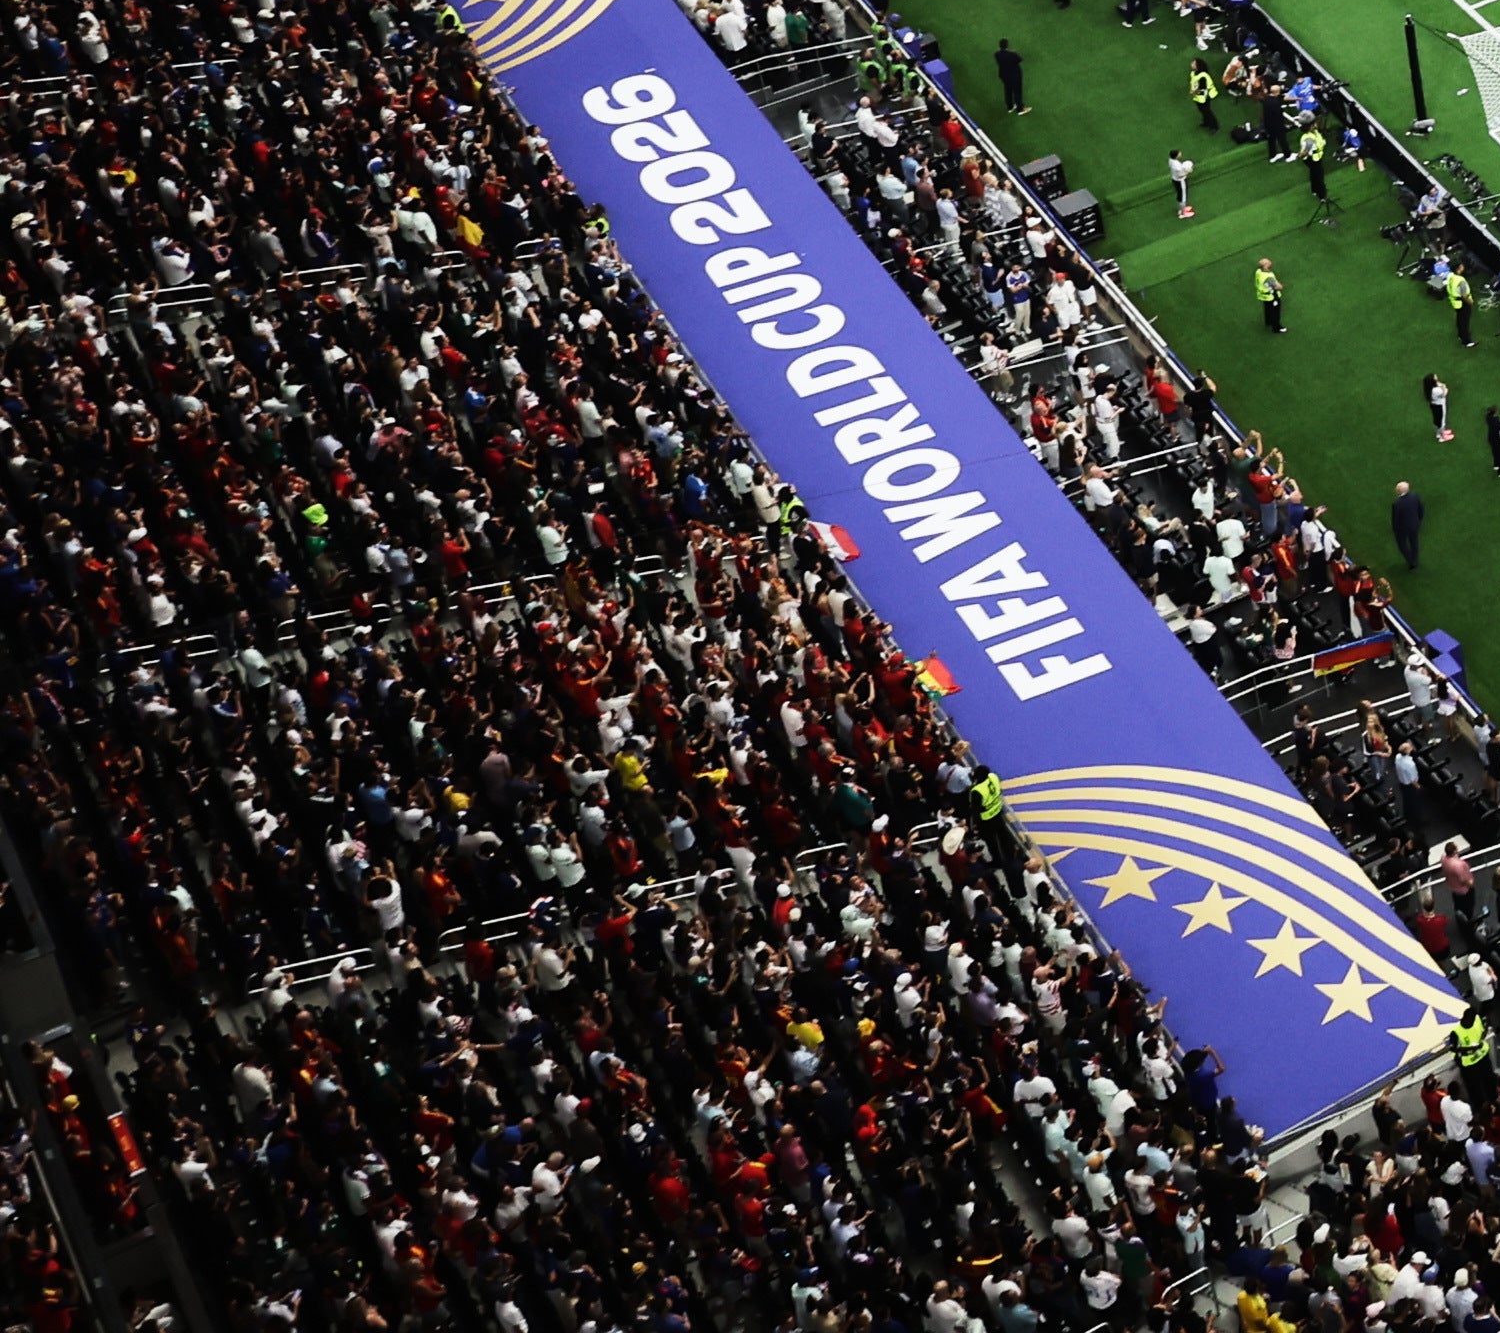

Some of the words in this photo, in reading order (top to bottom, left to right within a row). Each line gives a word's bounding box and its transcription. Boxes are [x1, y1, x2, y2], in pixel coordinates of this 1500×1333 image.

[582, 74, 772, 245] 2026
[705, 247, 846, 349] CUP
[785, 346, 1003, 563] WORLD
[938, 542, 1112, 701] FIFA
